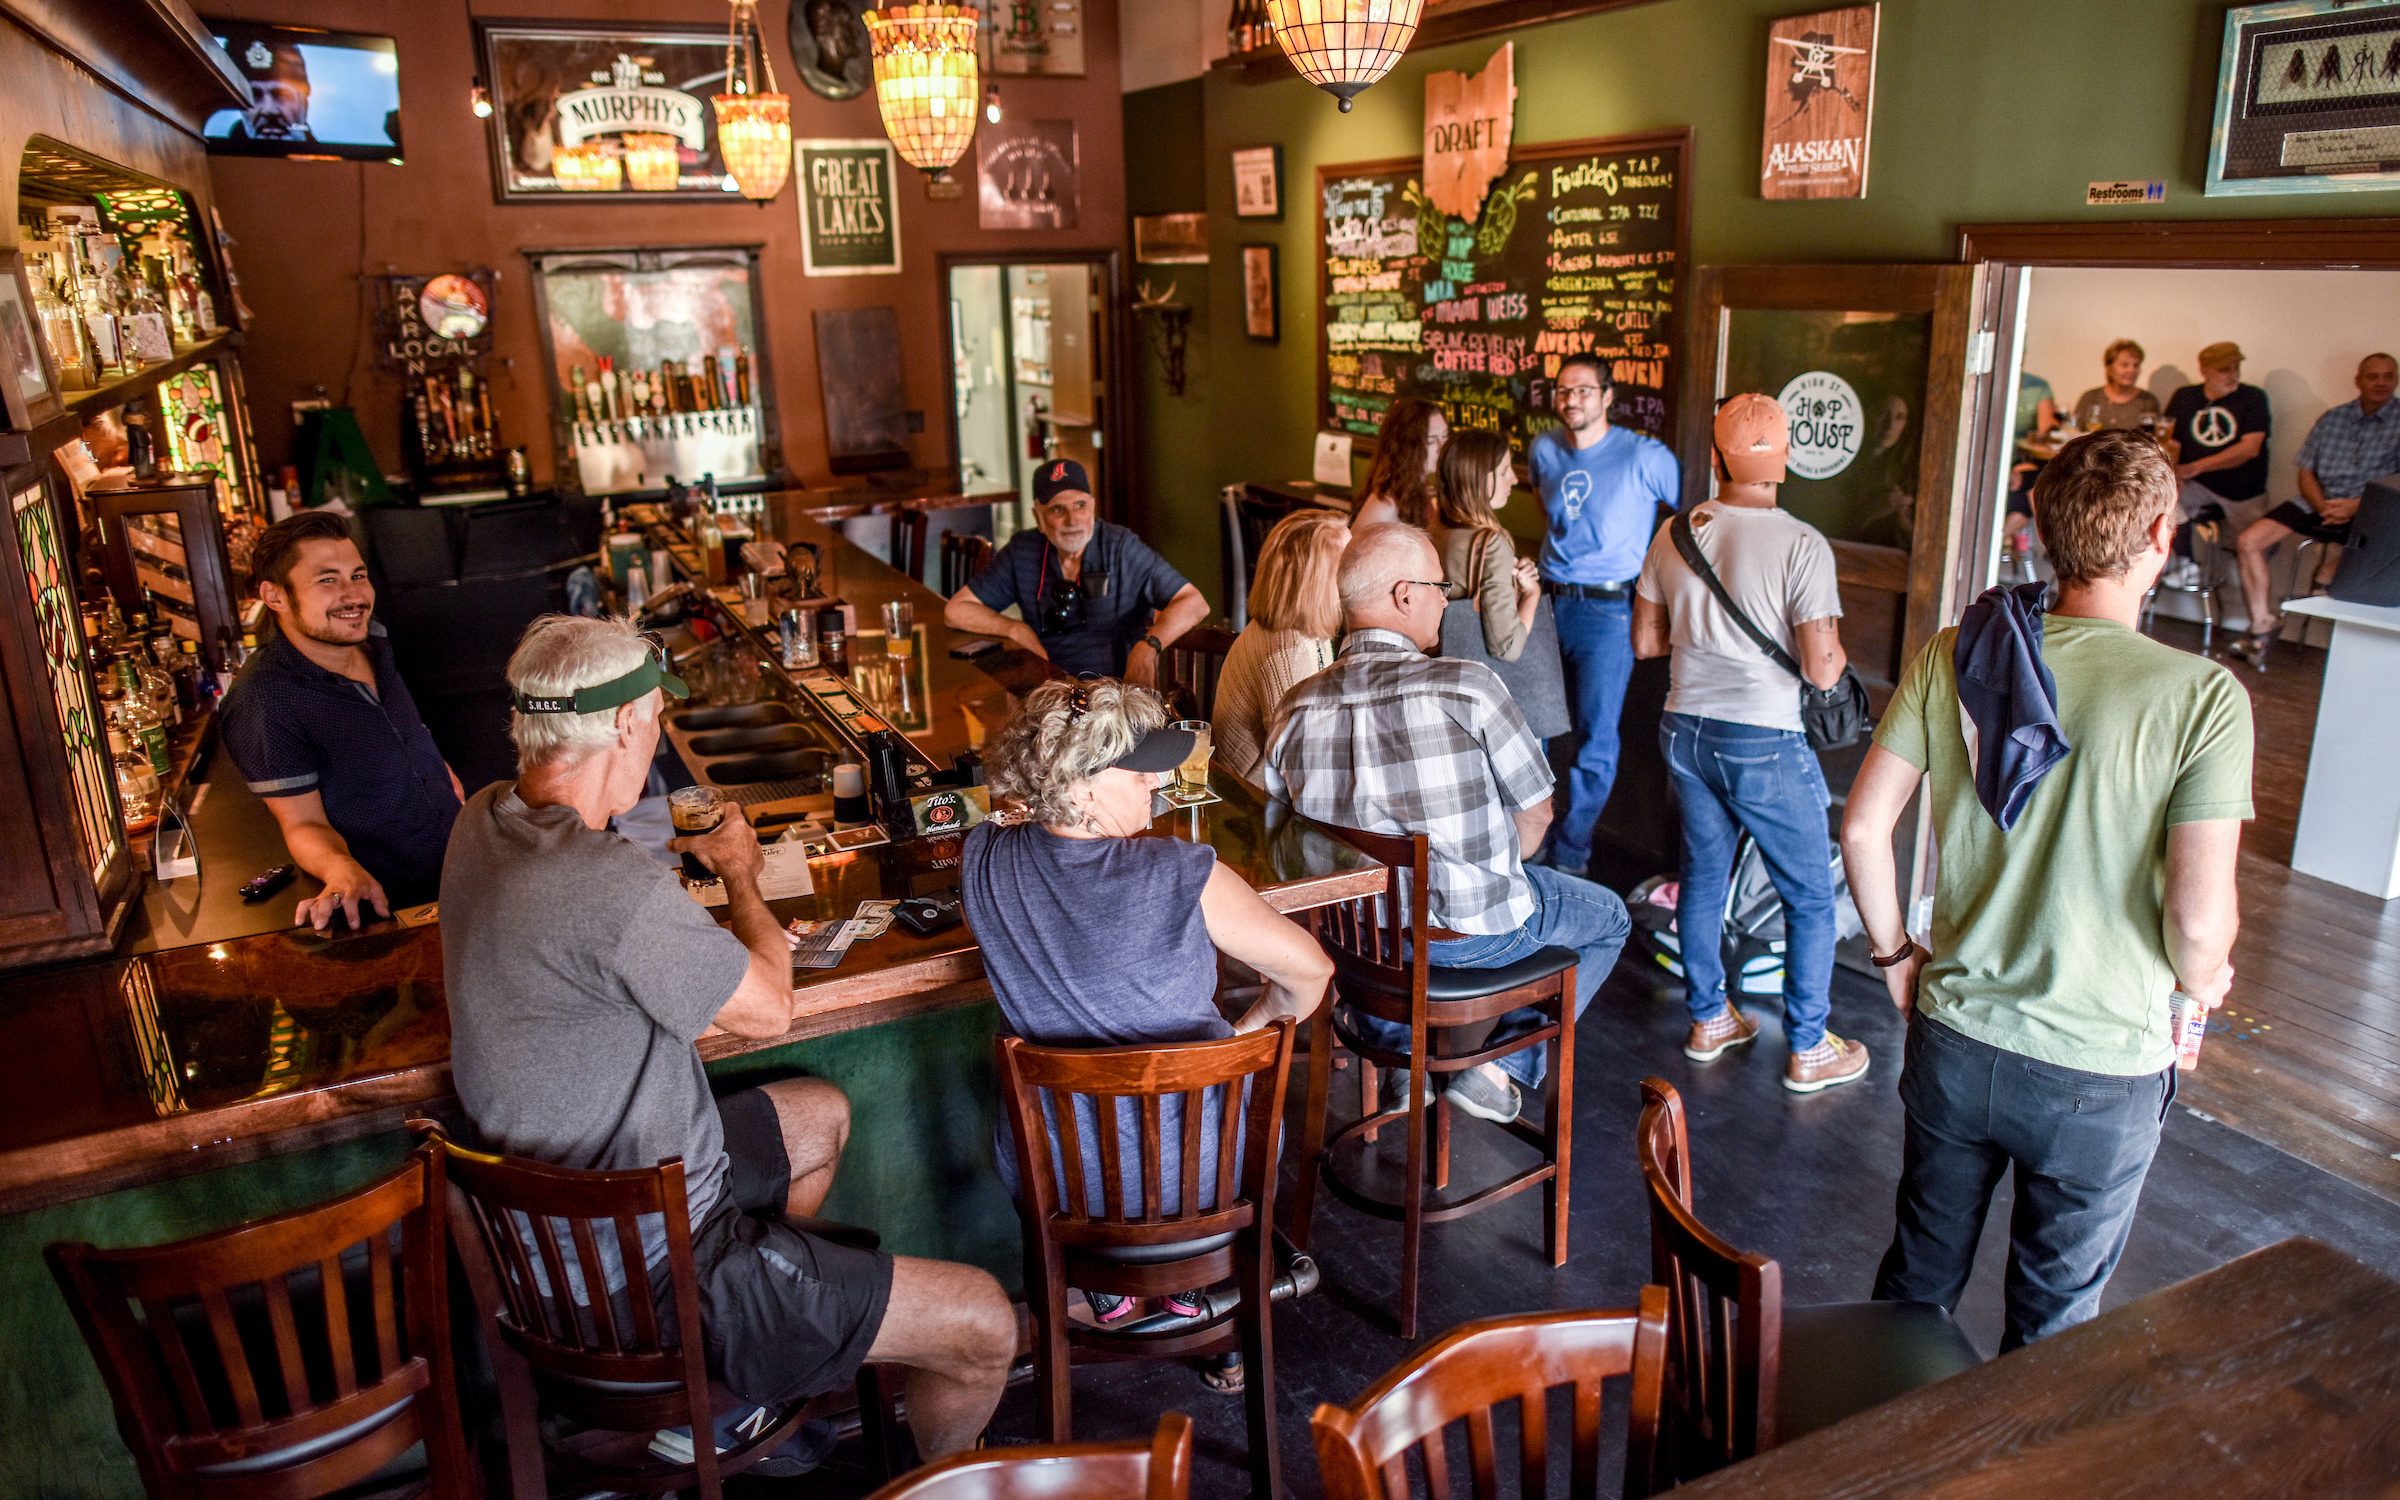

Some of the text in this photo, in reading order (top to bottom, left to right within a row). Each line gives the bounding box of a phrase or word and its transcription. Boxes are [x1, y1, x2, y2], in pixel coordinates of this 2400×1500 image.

[1430, 118, 1498, 153] DRAFT
[1626, 155, 1661, 174] TAP
[1762, 137, 1862, 181] ALASKAN
[812, 157, 882, 198] GREAT
[2089, 186, 2145, 199] Restrooms
[816, 196, 885, 236] LAKES
[1486, 294, 1529, 321] WEISS
[389, 339, 478, 359] LOCAL
[1534, 330, 1596, 356] AVERY
[1433, 349, 1486, 372] COFFEE
[1488, 354, 1517, 377] RED
[1611, 359, 1664, 389] AVEN
[1461, 402, 1500, 433] HIGH
[925, 819, 961, 834] Handmade
